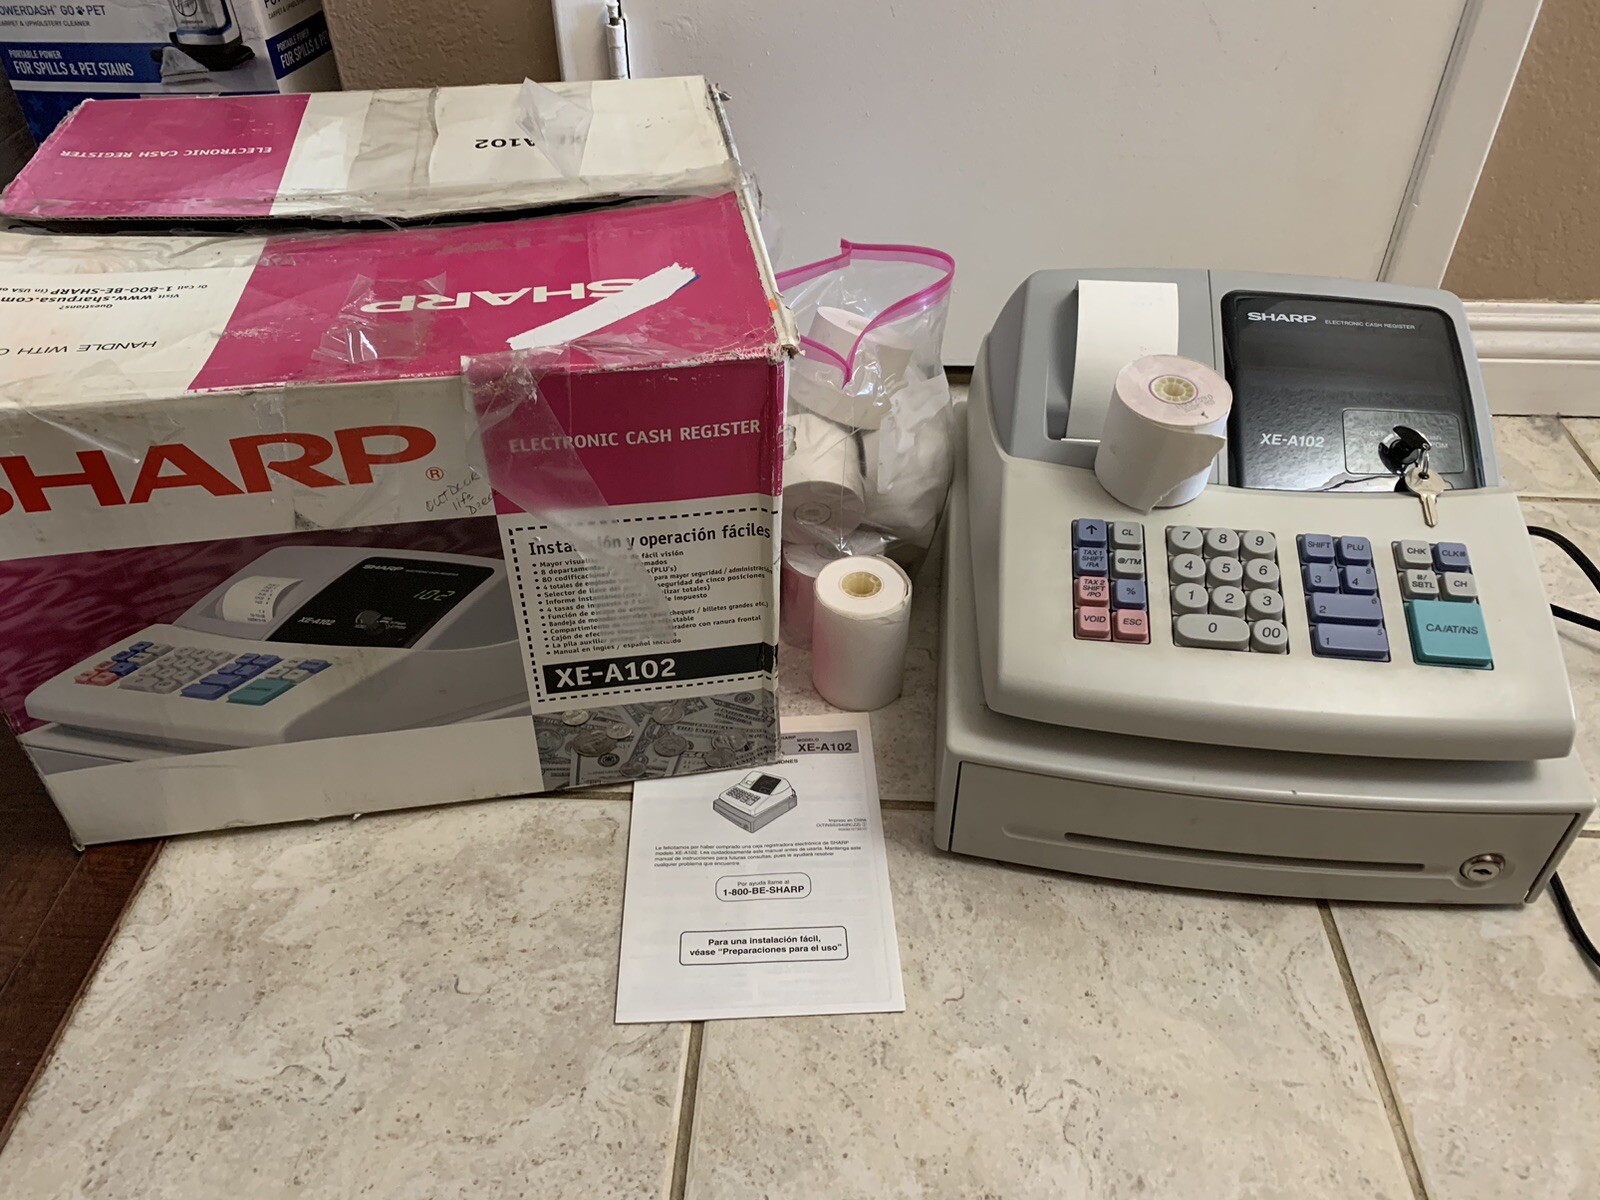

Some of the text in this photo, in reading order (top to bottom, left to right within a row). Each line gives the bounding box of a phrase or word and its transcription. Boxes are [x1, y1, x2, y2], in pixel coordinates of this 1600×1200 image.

[0, 5, 106, 16] OWERDASH GO PET
[8, 49, 62, 60] PORTABLE POWER
[13, 60, 135, 77] FOR SPILLS & PET STAINS
[60, 147, 273, 158] ELECTRONIC CASH REGISTER
[50, 286, 172, 295] 1-800-BE-SHARP
[1, 295, 152, 303] www.sharpusa.com
[1247, 311, 1317, 323] SHARP
[1324, 319, 1364, 327] ELECTRONIC
[1384, 322, 1416, 330] REGISTER
[17, 345, 68, 355] WITH
[77, 341, 158, 352] HANDLE
[508, 419, 761, 454] ELECTRONIC CASH REGISTER
[1260, 432, 1325, 449] XE-A102
[639, 528, 716, 549] operación
[721, 522, 771, 540] fáciles
[1121, 528, 1134, 536] CL
[1181, 531, 1191, 541] 7
[1218, 533, 1228, 544] 8
[1255, 536, 1264, 546] 9
[1307, 541, 1331, 549] SHIFT
[1346, 543, 1364, 551] PLU
[1407, 547, 1426, 555] CHK
[1441, 550, 1466, 558] CLK#
[540, 560, 563, 568] Mayor
[641, 551, 658, 559] fácil
[1117, 557, 1142, 566] @/TM
[1184, 560, 1194, 571] 4
[1221, 563, 1231, 574] 5
[1258, 565, 1268, 575] 6
[550, 582, 573, 590] totales
[691, 568, 722, 578] seguridad
[1314, 575, 1322, 584] 3
[1352, 577, 1359, 586] 4
[1453, 580, 1468, 588] CH
[544, 590, 575, 598] Selector
[727, 573, 765, 582] posiciones
[682, 584, 711, 593] totales)
[1412, 580, 1435, 589] SBTL
[413, 589, 456, 601] 102
[674, 592, 708, 601] impuesto
[1126, 587, 1136, 596] %
[1188, 590, 1195, 600] 1
[1224, 593, 1234, 604] 2
[1262, 596, 1272, 606] 3
[1319, 605, 1326, 614] 2
[548, 612, 577, 620] Función
[549, 619, 576, 628] Bandeja
[728, 602, 754, 611] grandes
[1084, 614, 1106, 624] VOID
[1122, 617, 1142, 627] ESC
[551, 634, 572, 642] Cajón
[713, 618, 736, 626] ranura
[737, 615, 762, 623] frontal
[1208, 622, 1218, 633] 0
[1426, 623, 1479, 636] CA/AT/NS
[1262, 627, 1281, 639] 00
[563, 640, 578, 649] pila
[1325, 637, 1330, 645] 1
[553, 647, 580, 655] Manual
[556, 658, 677, 688] XE-A102
[798, 742, 853, 753] XE-A102
[749, 880, 766, 888] ayuda
[722, 885, 805, 896] 1-800-BE-SHARP
[708, 938, 729, 946] Para
[749, 935, 798, 944] instalación
[799, 934, 821, 943] fácil,
[689, 947, 716, 956] véase
[788, 945, 809, 954] para
[811, 944, 819, 952] el
